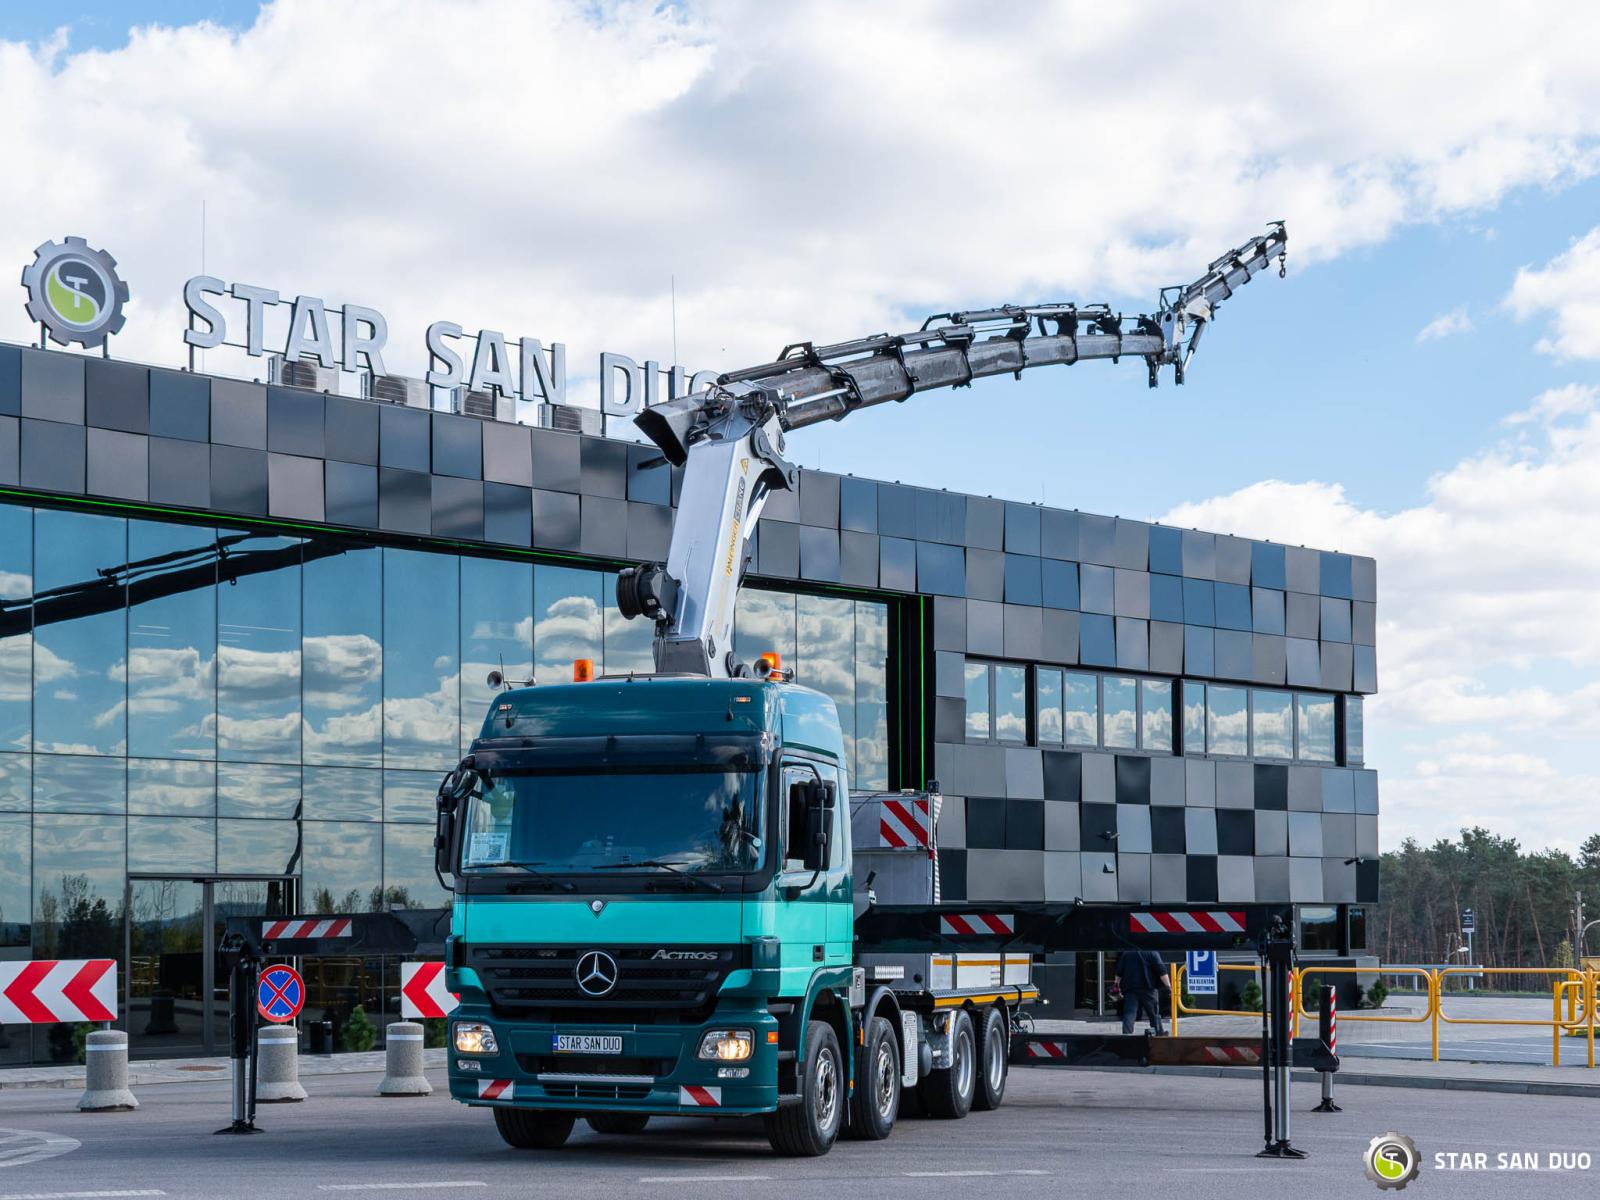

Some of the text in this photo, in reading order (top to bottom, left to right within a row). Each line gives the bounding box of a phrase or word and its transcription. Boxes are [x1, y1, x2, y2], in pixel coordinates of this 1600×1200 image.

[183, 275, 388, 378] STAR
[426, 320, 566, 406] SAN
[1193, 951, 1209, 971] P
[560, 1036, 620, 1051] STAR SAN DUO
